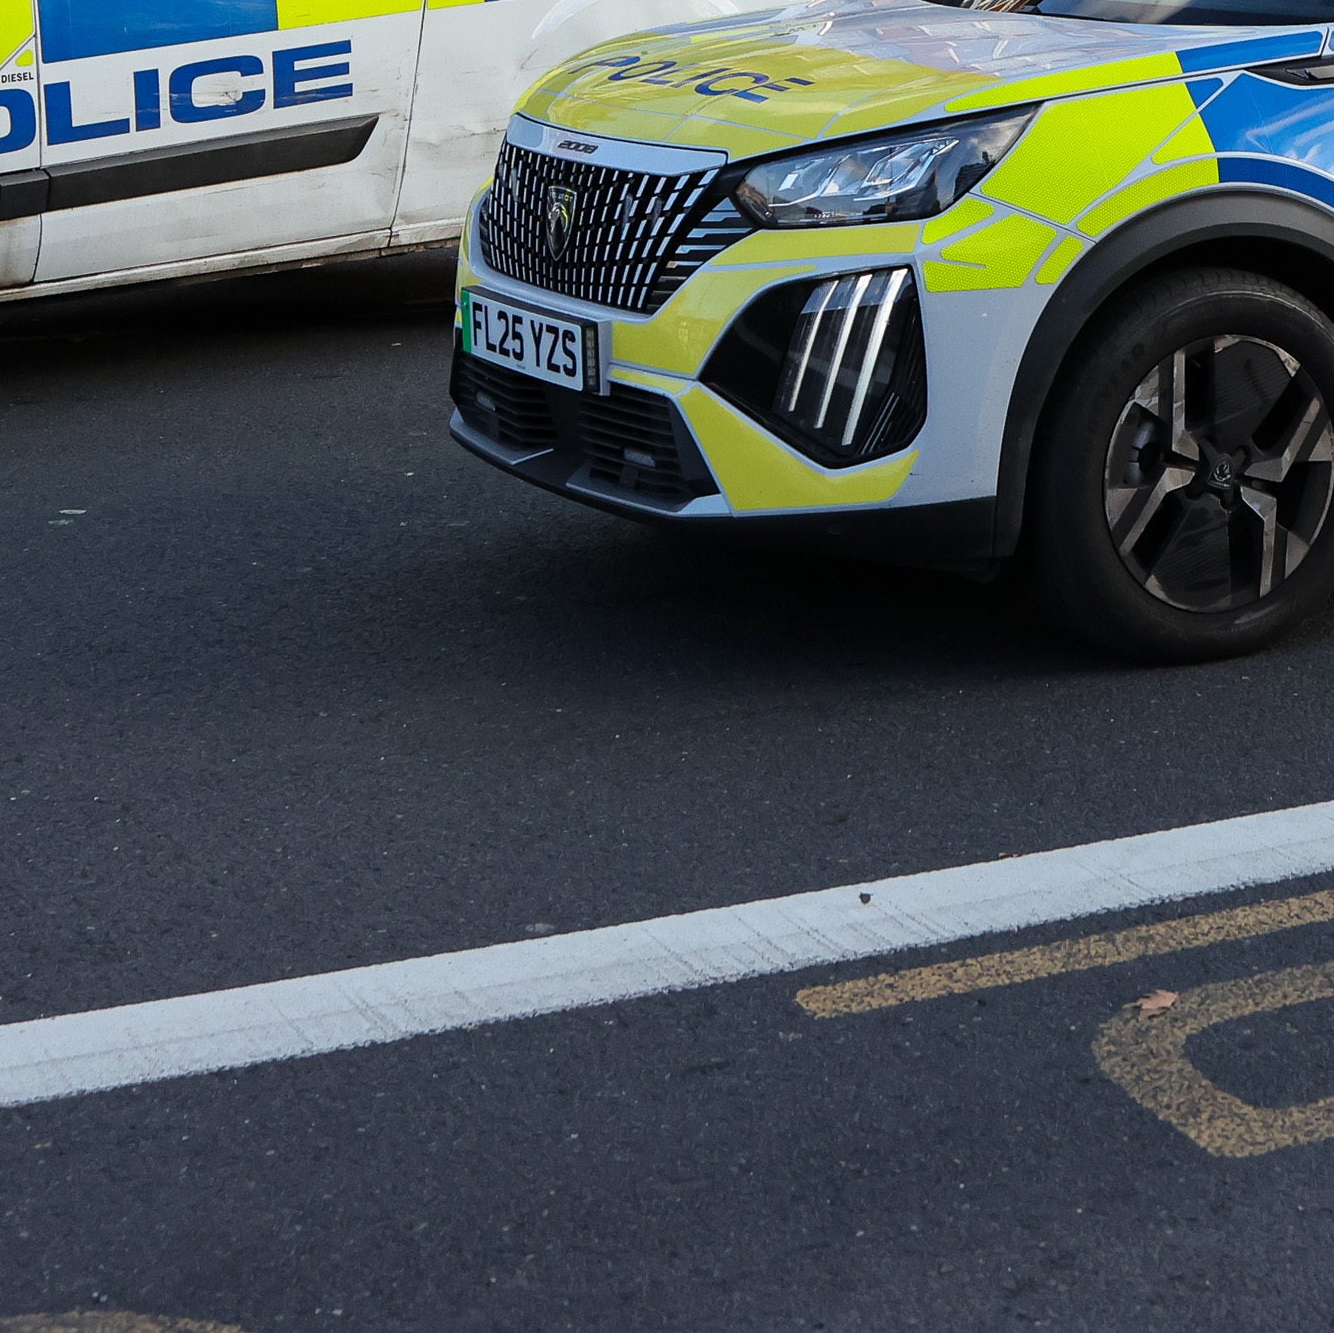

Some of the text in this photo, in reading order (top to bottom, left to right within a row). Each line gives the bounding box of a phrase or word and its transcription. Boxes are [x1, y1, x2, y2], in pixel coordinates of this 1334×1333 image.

[1, 72, 34, 83] DIESEL
[572, 54, 814, 104] POLICE
[558, 140, 598, 154] 2008
[473, 304, 578, 379] FL25 YZS
